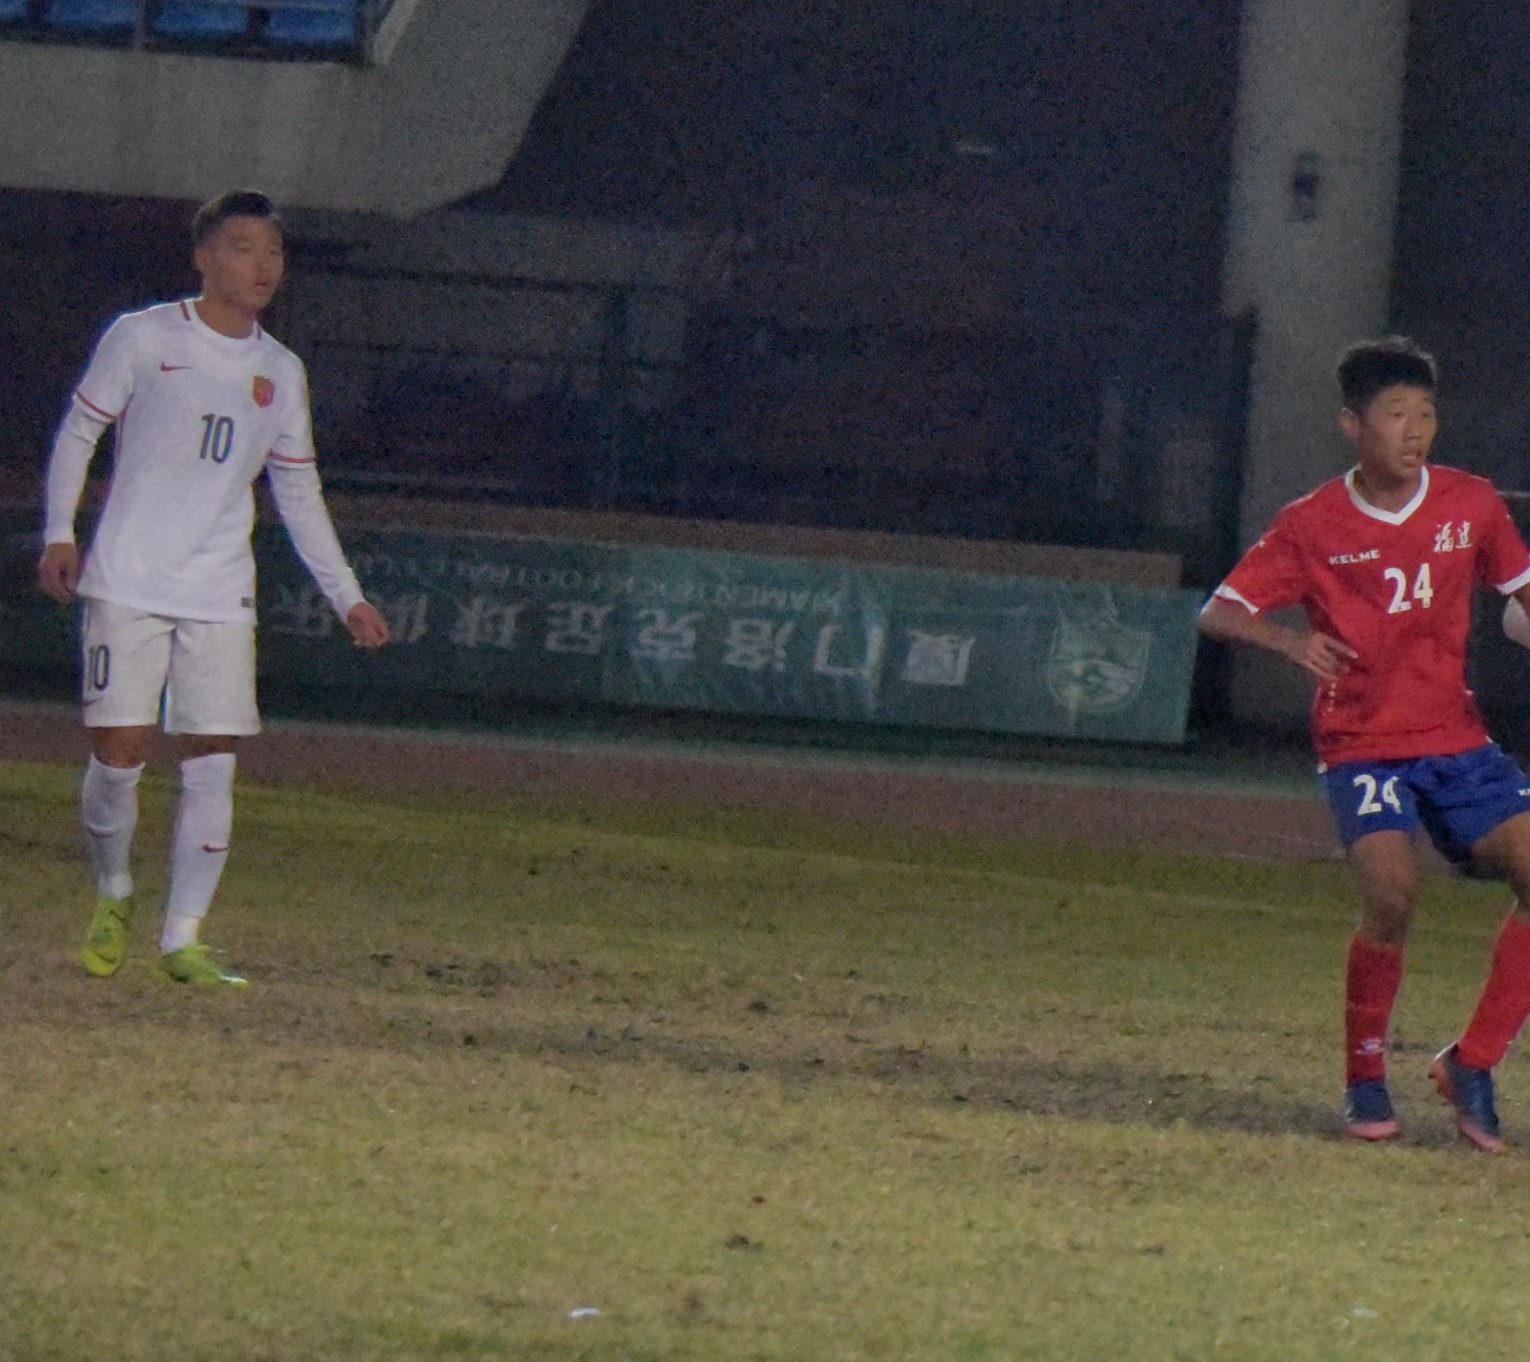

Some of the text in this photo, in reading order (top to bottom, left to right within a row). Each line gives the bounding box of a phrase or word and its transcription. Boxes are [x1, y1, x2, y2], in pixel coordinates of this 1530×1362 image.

[199, 413, 235, 464] 10
[1328, 549, 1381, 566] KELME
[1384, 562, 1434, 614] 24
